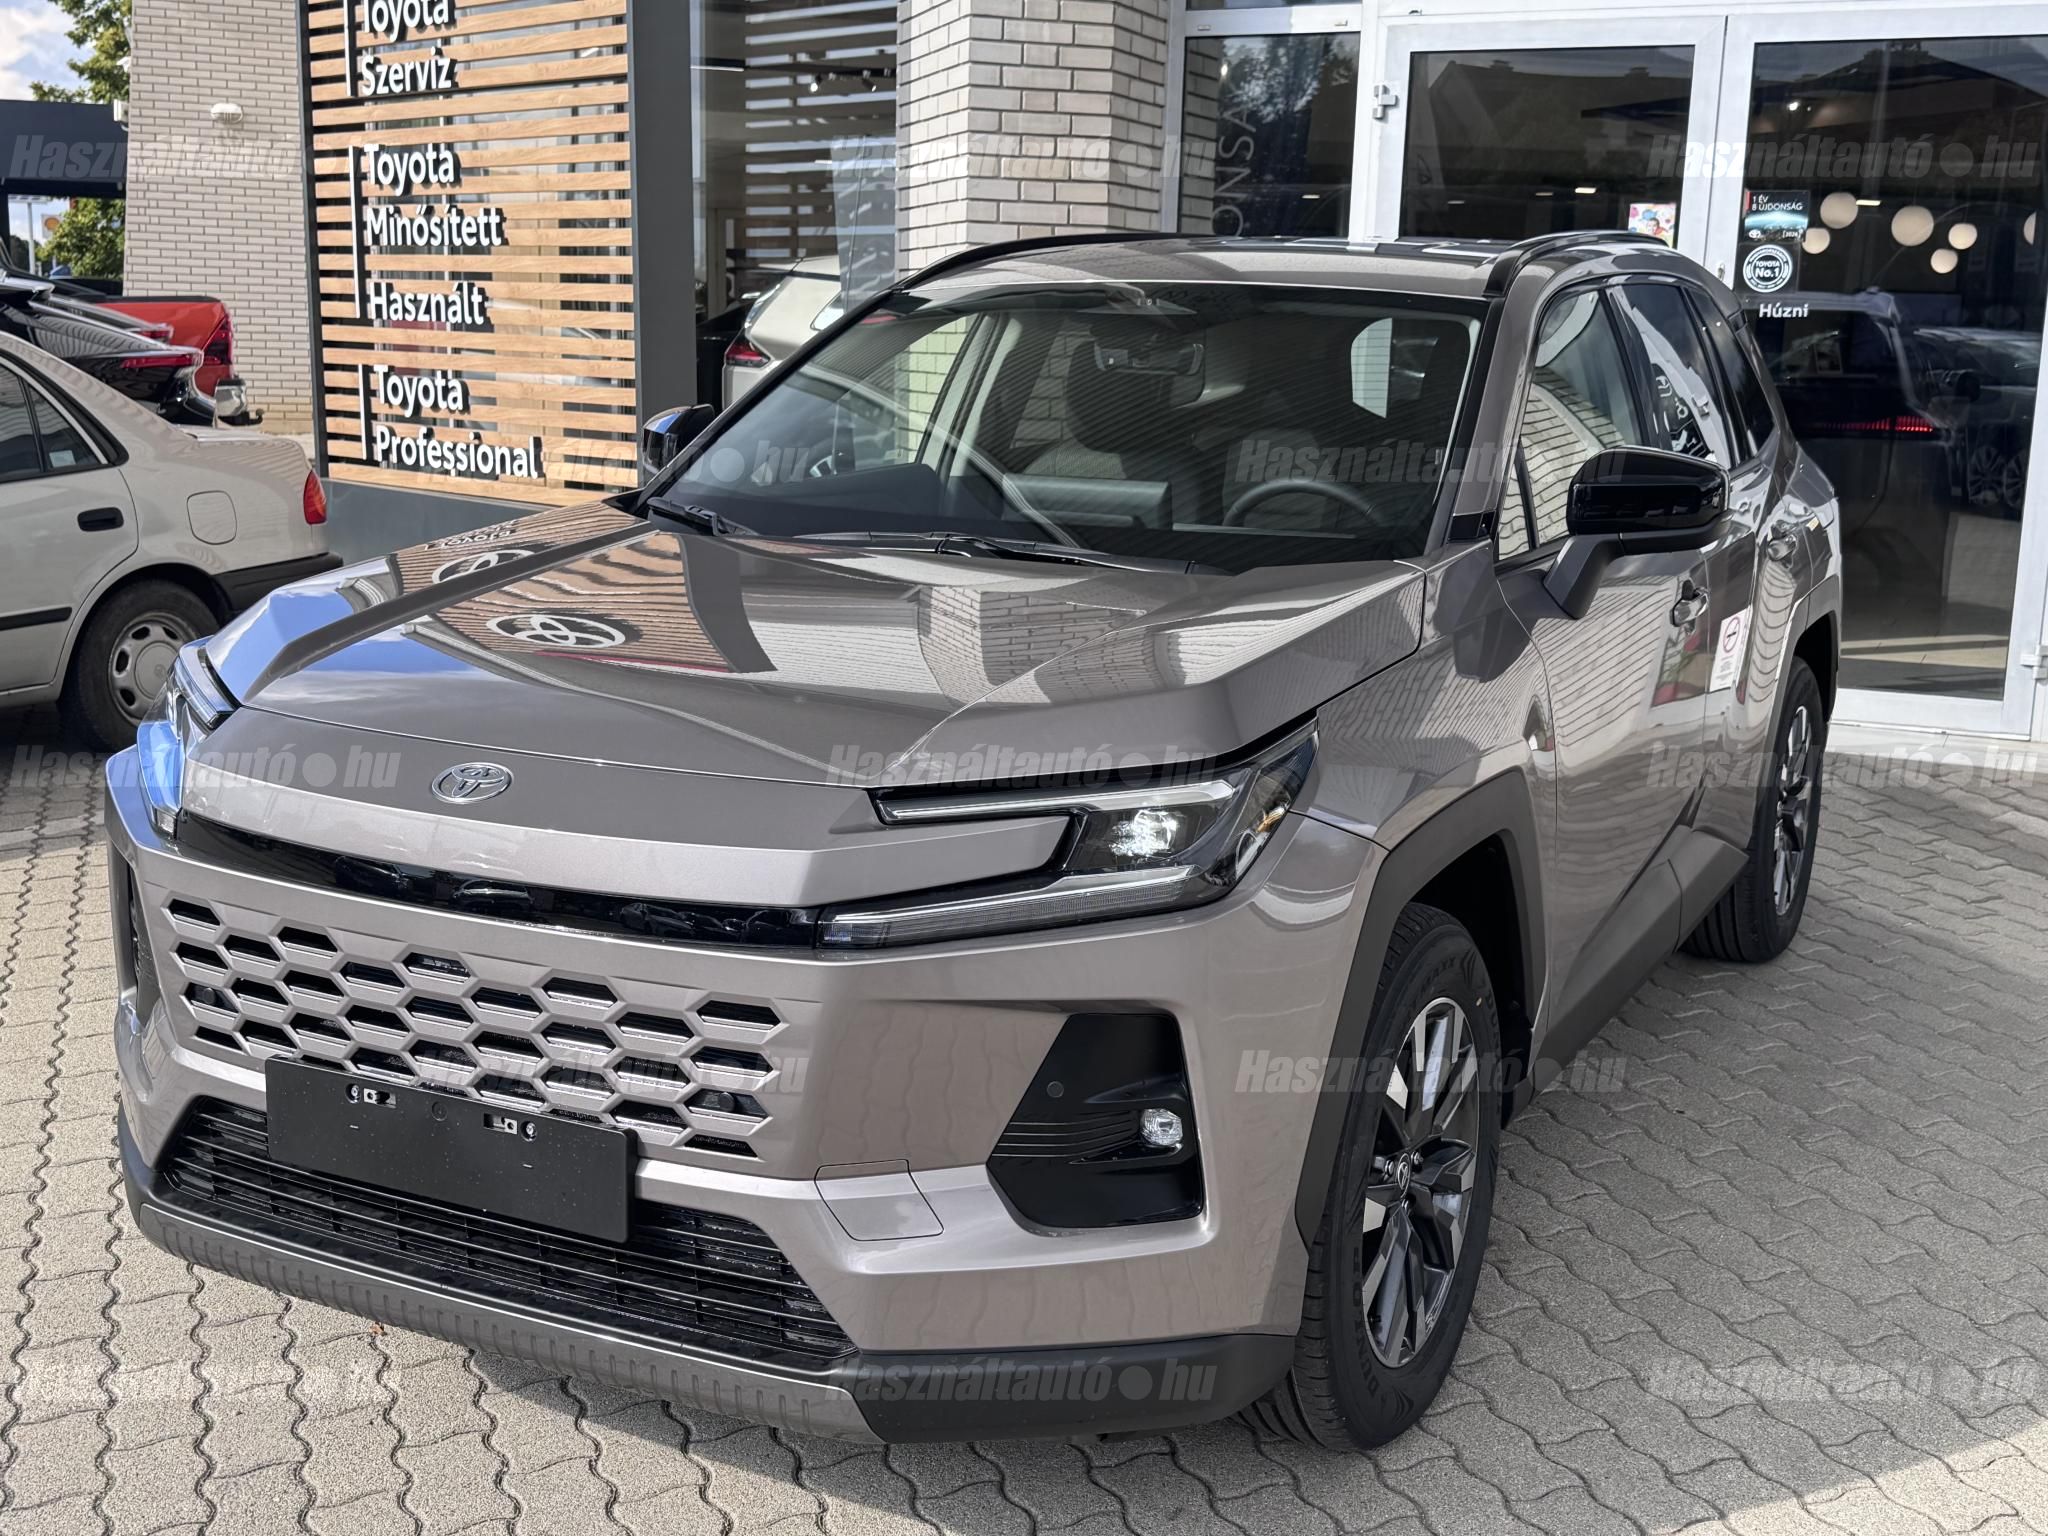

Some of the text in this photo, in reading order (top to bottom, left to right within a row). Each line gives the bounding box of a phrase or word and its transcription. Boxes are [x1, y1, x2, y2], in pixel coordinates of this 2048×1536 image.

[361, 46, 452, 96] Szerviz
[364, 143, 455, 196] Toyota
[366, 204, 502, 247] Minősített
[1755, 260, 1781, 268] TOYOTA
[1755, 267, 1781, 278] No.1
[369, 281, 485, 326] Használt
[1758, 302, 1809, 319] Húzni
[373, 364, 464, 418] Toyota
[376, 424, 538, 480] Professional
